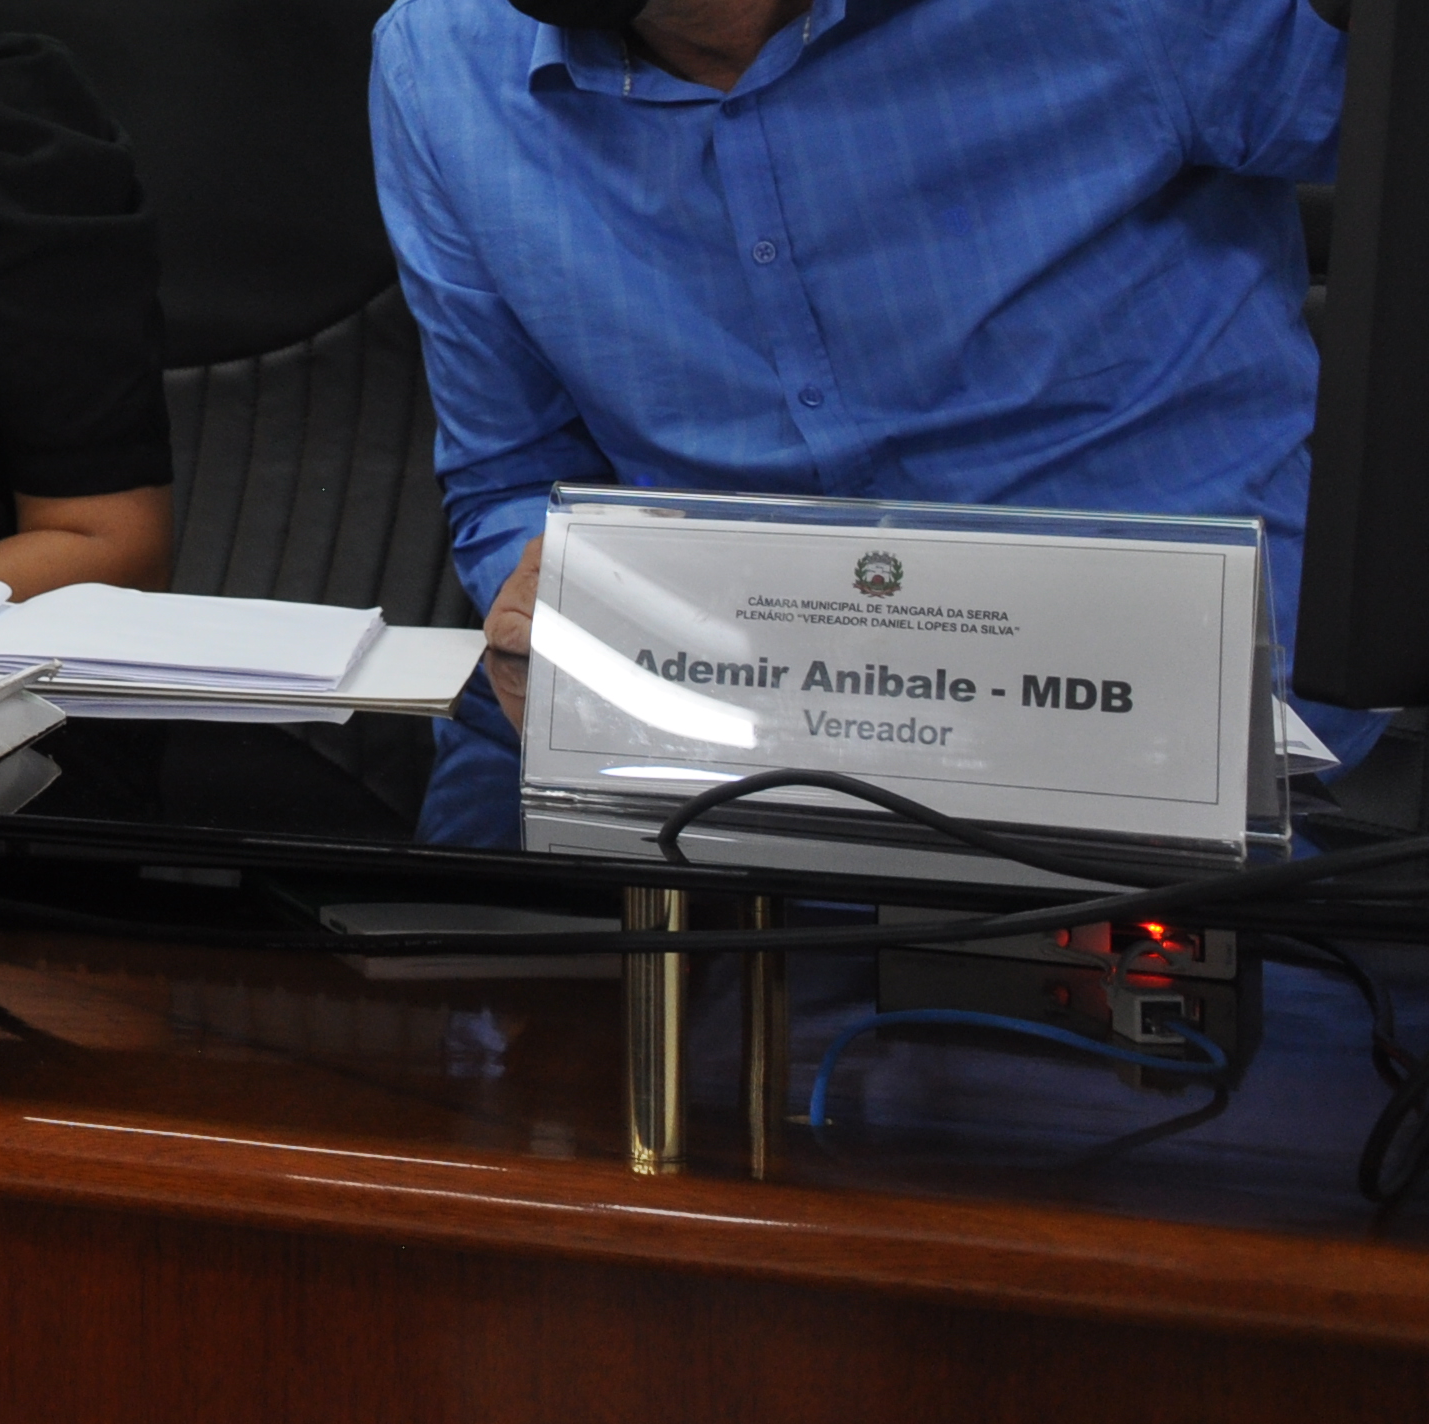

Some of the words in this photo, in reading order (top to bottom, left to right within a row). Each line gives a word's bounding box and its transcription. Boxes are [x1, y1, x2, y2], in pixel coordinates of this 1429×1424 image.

[735, 609, 794, 622] PLENÁRIO
[871, 617, 915, 630] DANIEL
[917, 620, 958, 633] LOPES
[960, 623, 978, 634] DA
[747, 595, 799, 609] CÂMARA
[800, 599, 864, 613] MUNICIPAL
[866, 603, 883, 614] DE
[885, 604, 943, 618] TANGARÁ
[946, 608, 964, 619] DA
[966, 610, 1009, 622] SERRA
[635, 648, 790, 689] Ademir
[801, 659, 976, 702] Anibale
[991, 688, 1006, 697] -
[1020, 674, 1134, 714] MDB
[803, 709, 954, 747] Vereador
